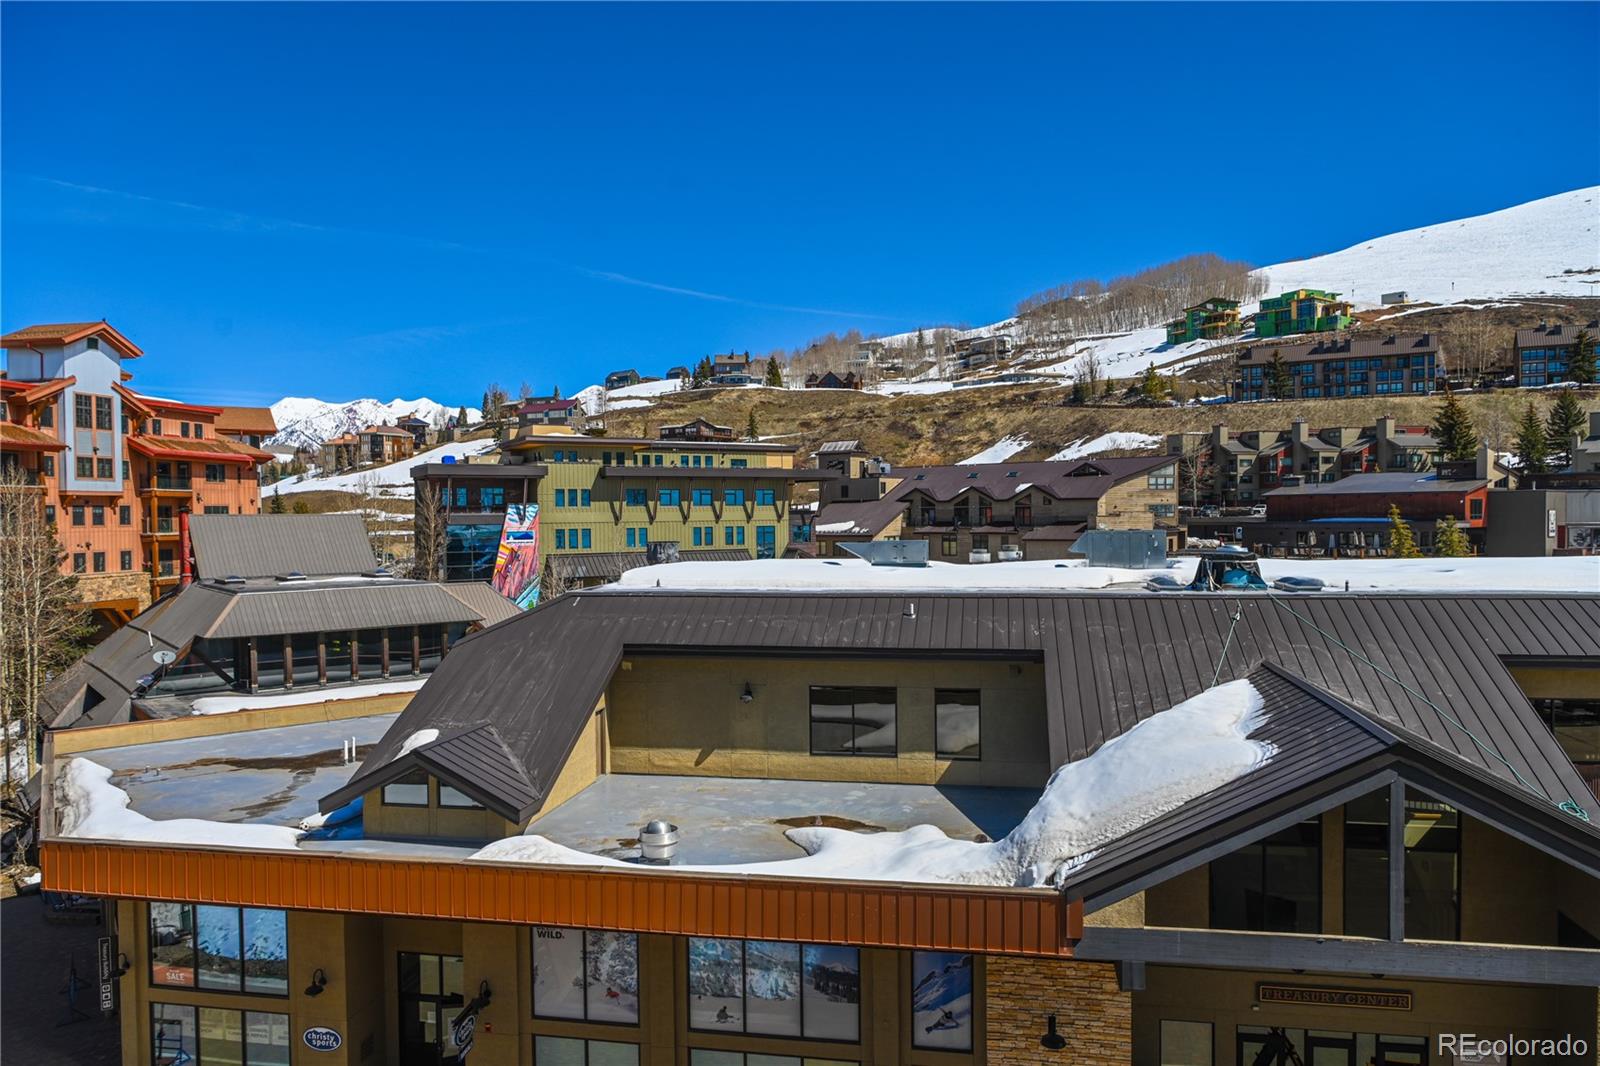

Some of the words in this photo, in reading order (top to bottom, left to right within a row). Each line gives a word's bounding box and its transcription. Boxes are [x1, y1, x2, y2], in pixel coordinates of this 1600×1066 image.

[536, 930, 565, 939] WILD.
[166, 972, 185, 981] SALE
[1263, 989, 1341, 1003] TREASURY
[1344, 993, 1409, 1007] CENTER
[307, 1031, 335, 1042] christy
[312, 1039, 337, 1047] sports
